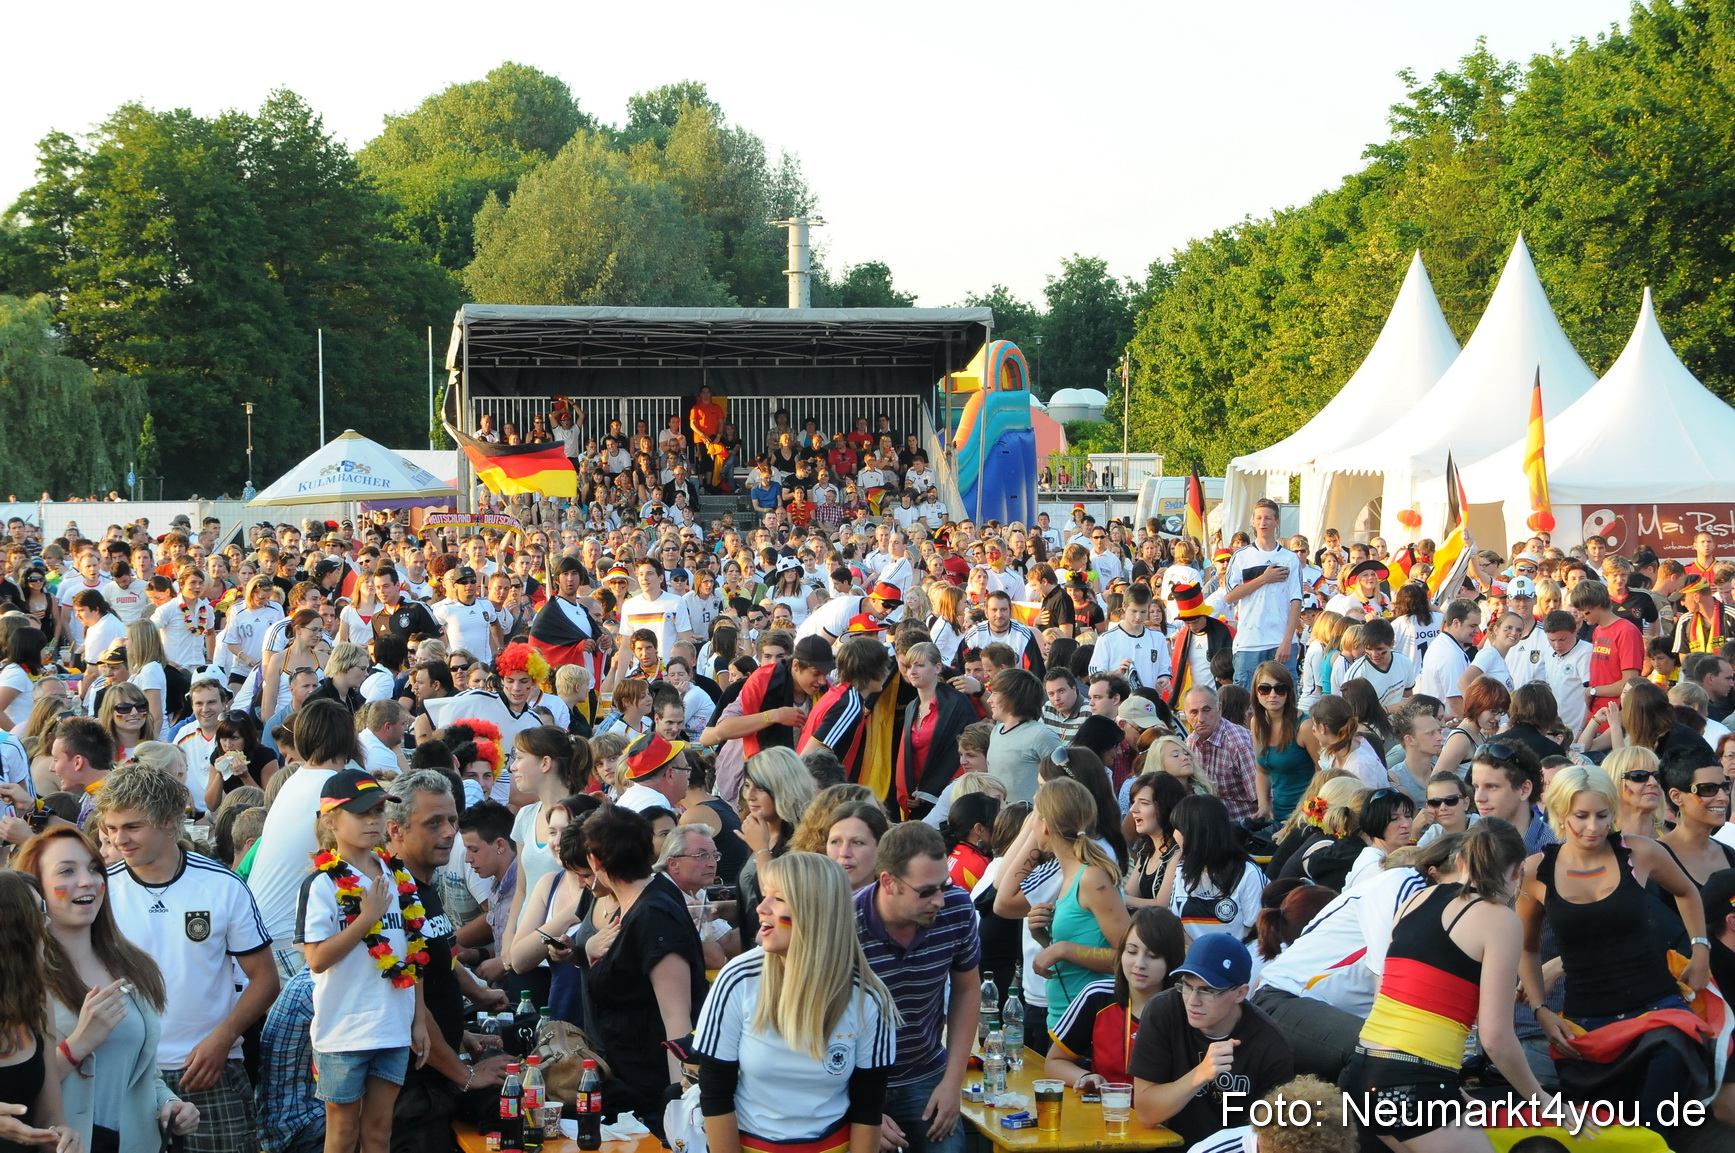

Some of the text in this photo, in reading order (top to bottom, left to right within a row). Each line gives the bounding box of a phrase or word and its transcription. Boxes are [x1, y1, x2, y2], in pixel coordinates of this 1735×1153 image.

[297, 473, 391, 493] KULMBACHER
[1638, 504, 1684, 540] Mai
[116, 596, 137, 604] PUMA
[702, 612, 711, 623] 13
[240, 624, 254, 638] 13
